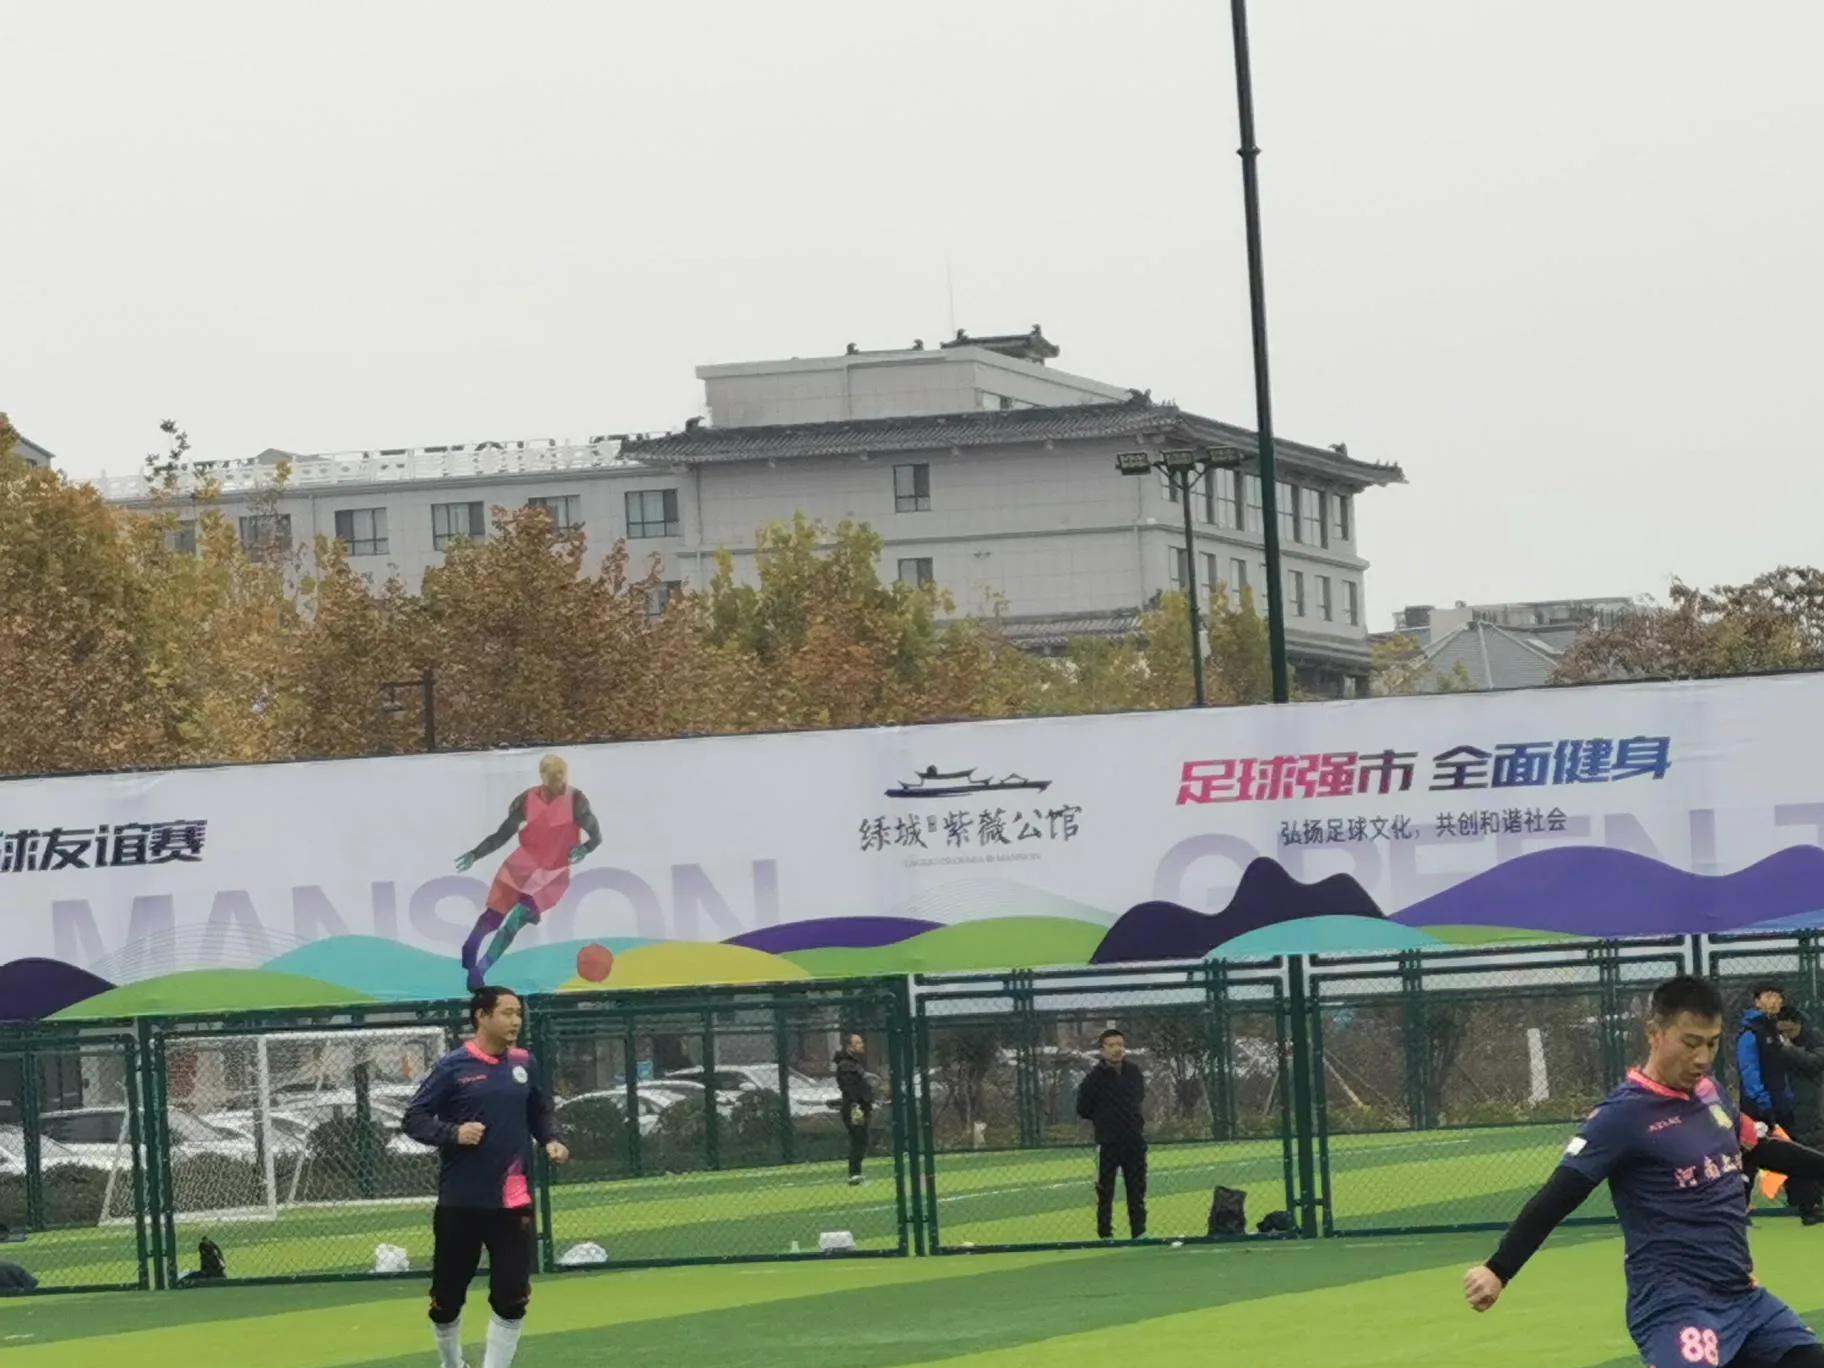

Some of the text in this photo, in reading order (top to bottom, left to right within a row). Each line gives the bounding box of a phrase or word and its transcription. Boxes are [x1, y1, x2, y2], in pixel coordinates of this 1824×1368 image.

[1175, 735, 1672, 806] 足球强市 全面健身
[0, 819, 208, 873] 球友谊赛
[52, 858, 780, 980] MANSON
[1680, 1326, 1719, 1368] 88
